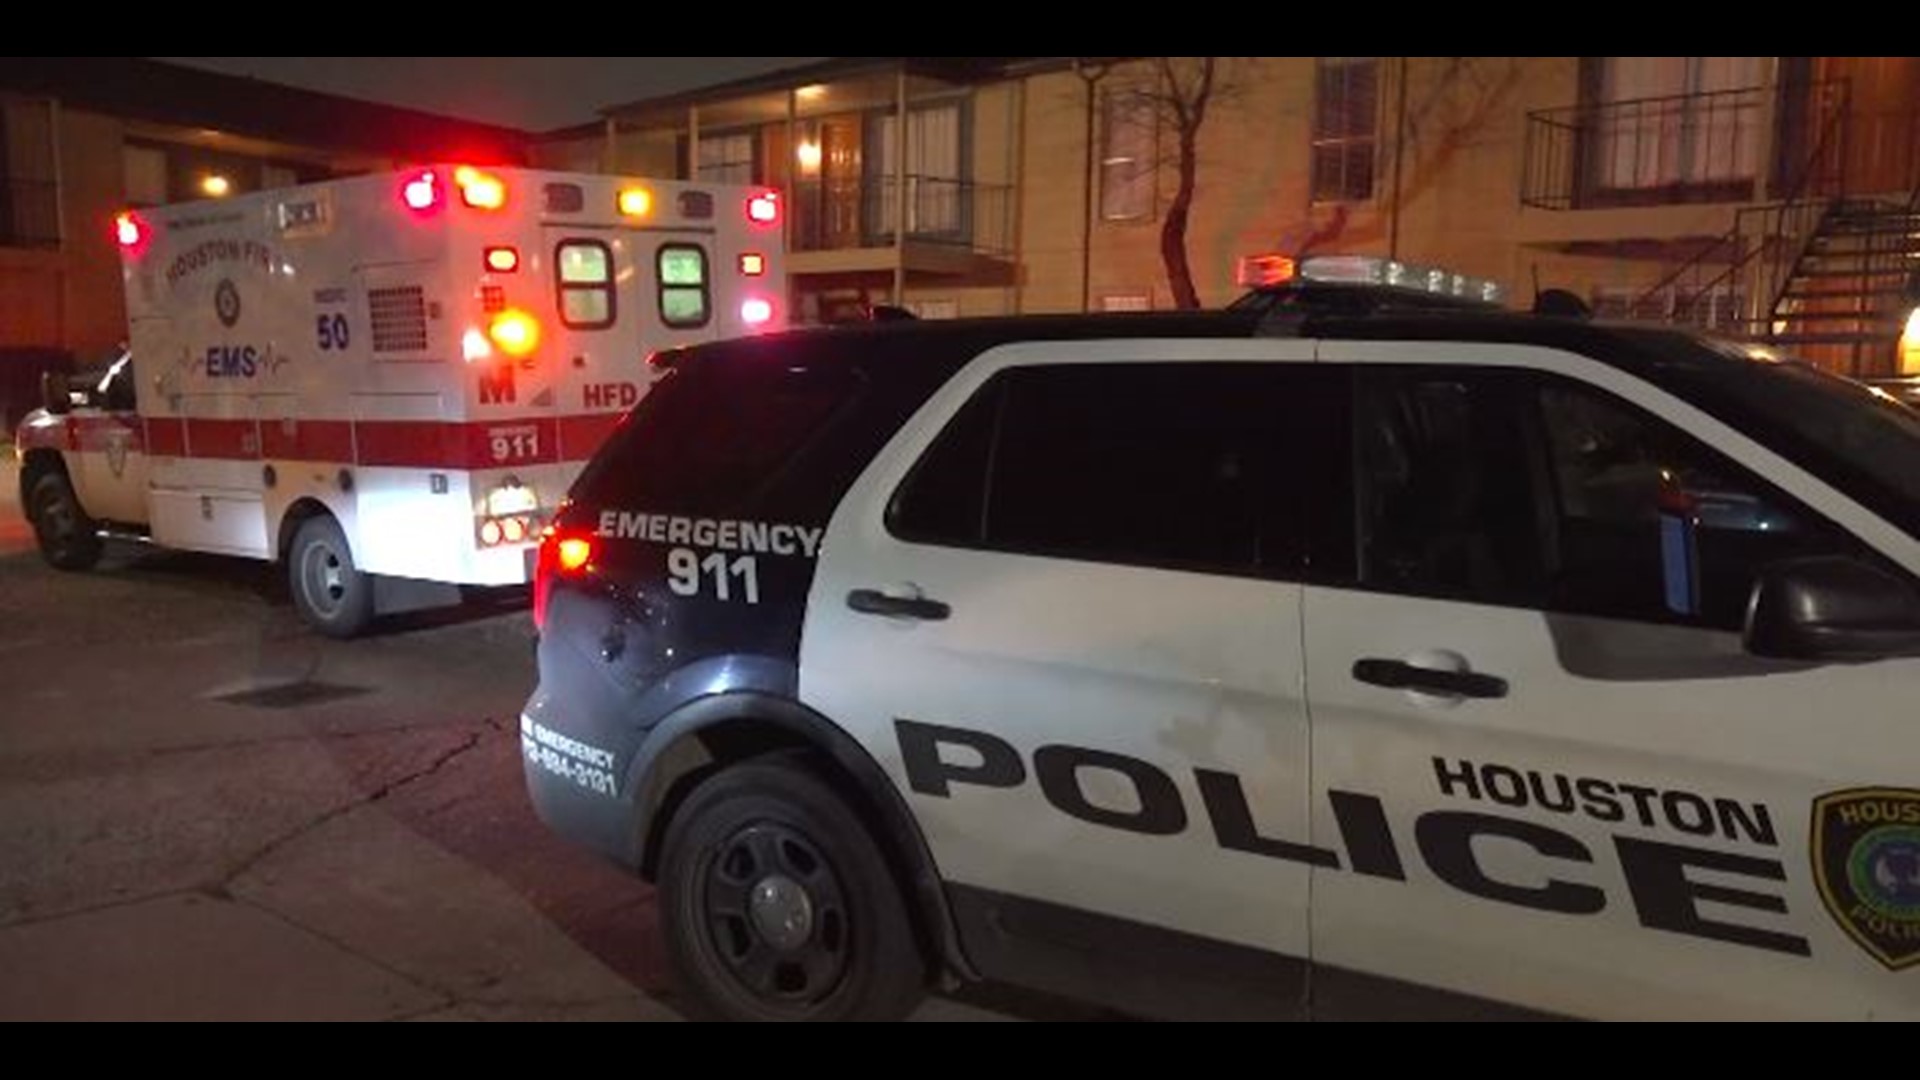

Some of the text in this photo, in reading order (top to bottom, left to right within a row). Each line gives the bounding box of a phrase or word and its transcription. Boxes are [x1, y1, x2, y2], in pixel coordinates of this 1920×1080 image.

[165, 239, 239, 282] HOUSTON
[317, 313, 349, 350] 50
[206, 346, 257, 377] EMS
[583, 382, 637, 407] HFD
[491, 434, 539, 461] 911
[600, 511, 822, 557] EMERGENCY
[667, 549, 758, 604] 911
[535, 724, 615, 770] EMERGENCY
[1432, 756, 1778, 846] HOUSTON
[894, 718, 1812, 957] POLICE
